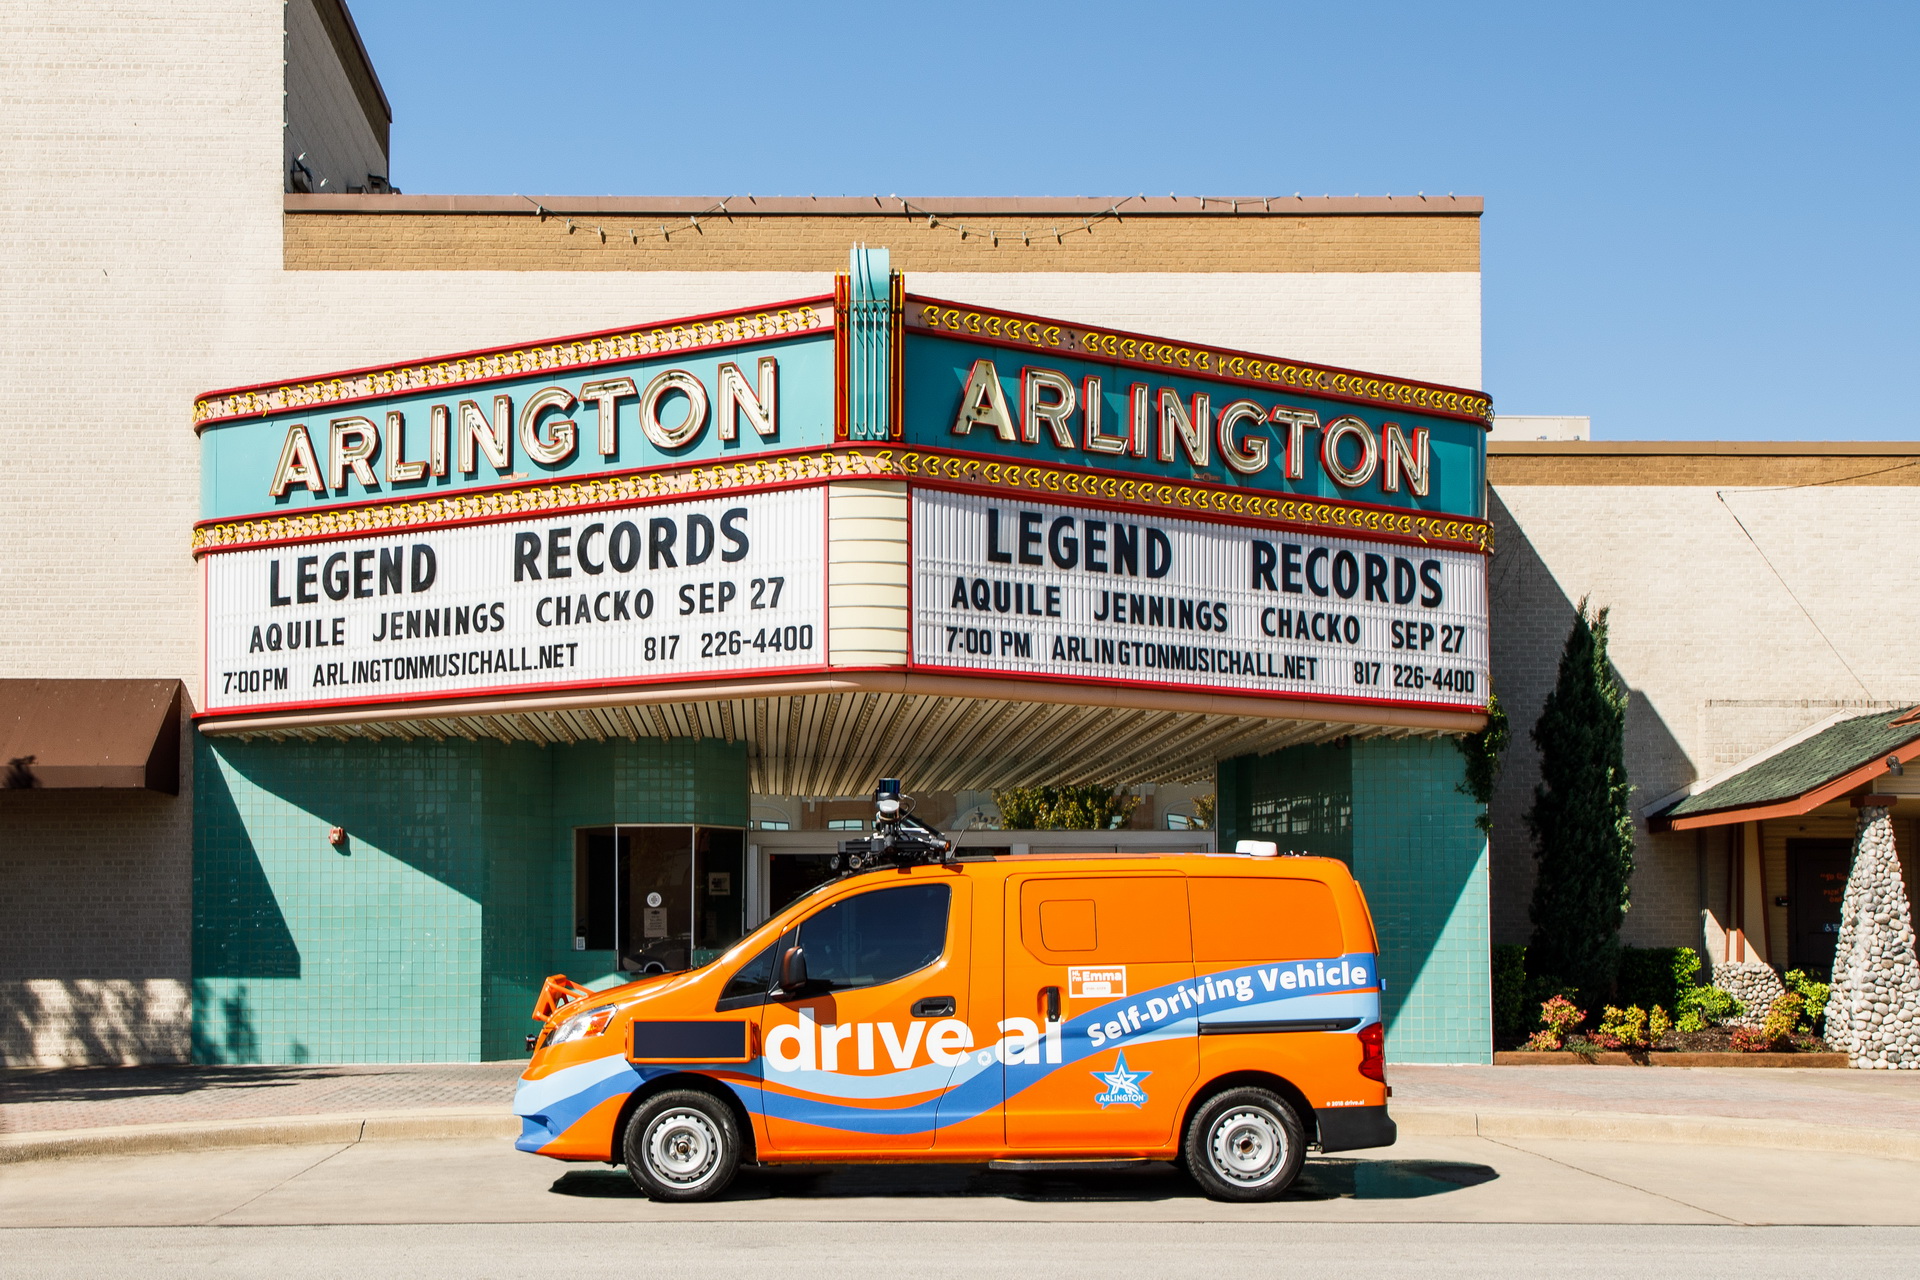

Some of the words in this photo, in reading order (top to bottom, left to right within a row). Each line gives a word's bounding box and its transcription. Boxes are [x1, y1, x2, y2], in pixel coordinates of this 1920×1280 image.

[269, 356, 778, 497] ARLINGTON
[952, 358, 1430, 497] ARLINGTON
[270, 543, 437, 608] LEGEND
[513, 507, 750, 582] RECORDS
[987, 507, 1172, 580] LEGEND
[1251, 539, 1443, 609] RECORDS
[249, 617, 346, 654] AQUILE
[372, 602, 505, 642] JENNINGS
[536, 588, 654, 628] CHACKO
[678, 581, 736, 616] SEP
[750, 576, 785, 610] 27
[951, 576, 1061, 618] AQUILE
[1093, 590, 1228, 633] JENNINGS
[1260, 606, 1361, 645] CHACKO
[1391, 619, 1435, 651] SEP
[1440, 624, 1465, 654] 27
[312, 642, 579, 687] ARLINGTONMUSICHALL.NET
[644, 634, 680, 662] 817
[701, 624, 813, 658] 226-4400
[946, 626, 992, 656] 7:00
[1000, 630, 1031, 658] PM
[1051, 635, 1318, 681] ARLINGTONMUSICHALL.NET
[1353, 661, 1381, 686] 817
[1393, 663, 1475, 694] 226-4400
[1082, 971, 1122, 981] Emma
[1087, 975, 1252, 1048] Self-Driving
[1257, 961, 1367, 992] Vehicle
[764, 1007, 1063, 1072] drive.ai
[1099, 1094, 1144, 1102] ARLINGTON
